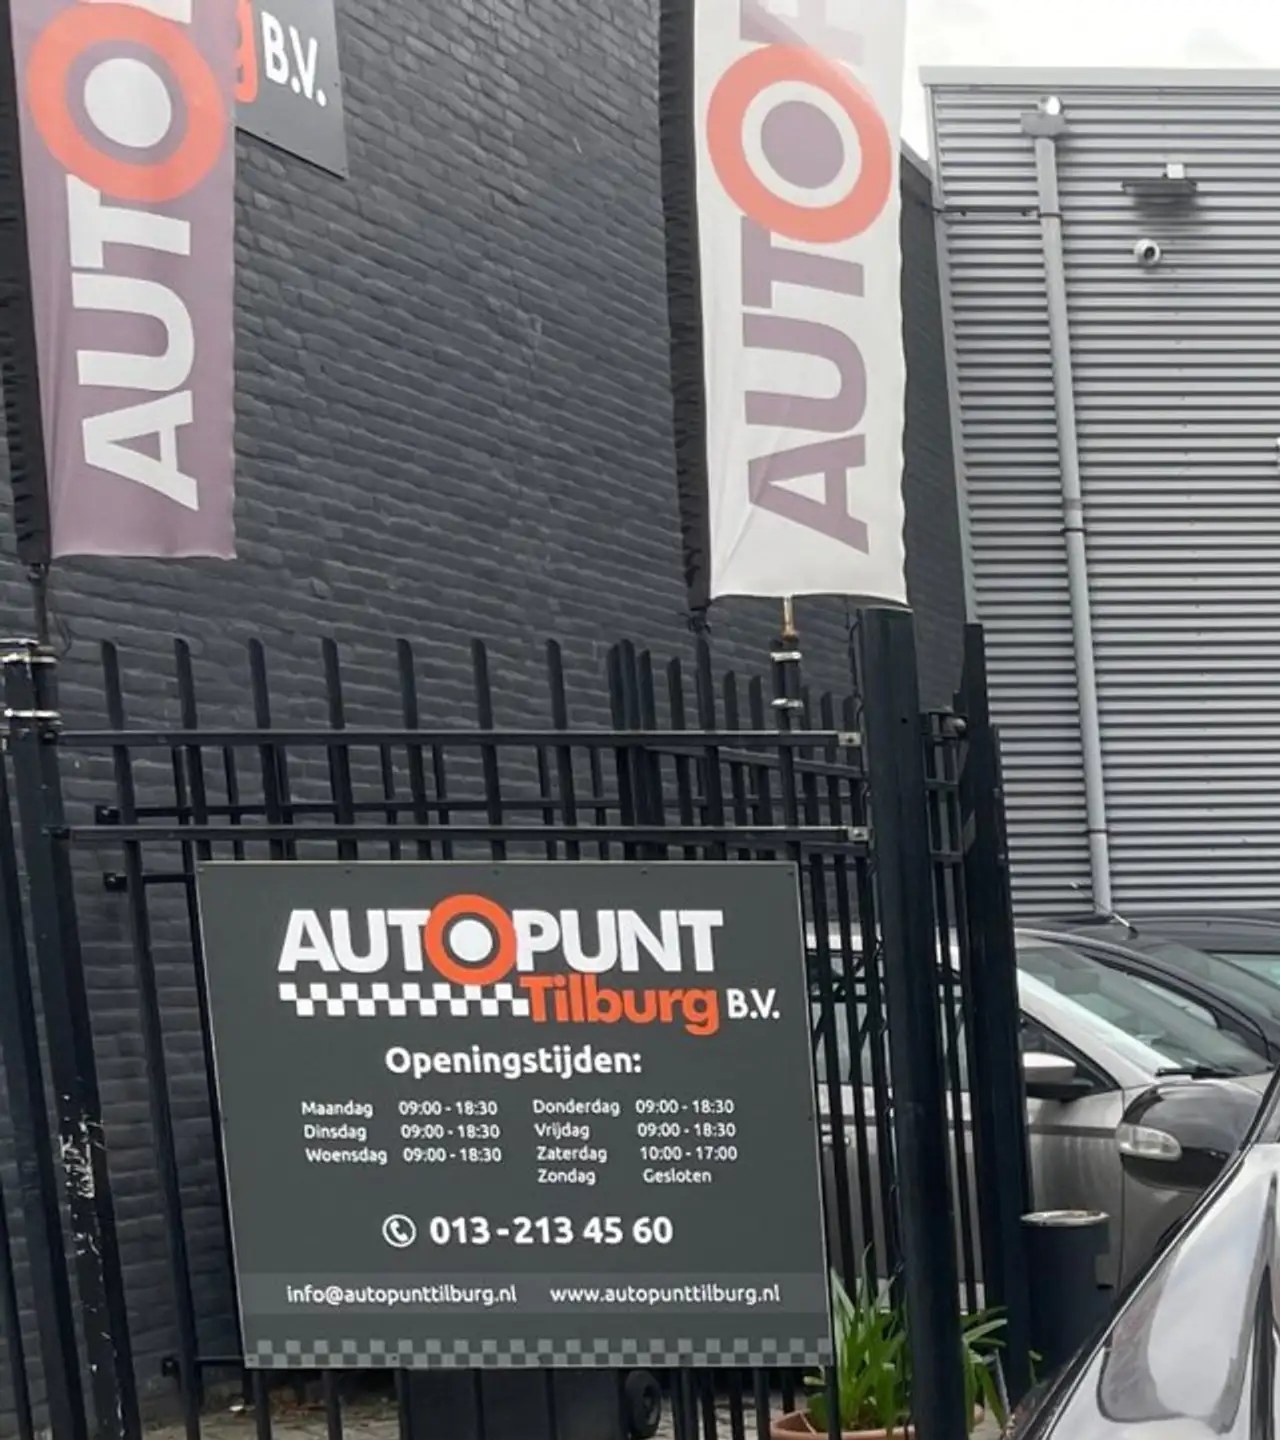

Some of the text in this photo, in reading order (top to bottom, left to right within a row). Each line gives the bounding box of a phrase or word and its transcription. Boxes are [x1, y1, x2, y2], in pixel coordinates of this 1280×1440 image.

[261, 11, 327, 107] B.V.
[26, 0, 226, 512] AUTO
[278, 894, 723, 986] AUTOPUNT
[520, 974, 780, 1036] Tilburg B.V.
[385, 1045, 642, 1080] Openingstijden:
[301, 1099, 374, 1119] Maandag
[398, 1101, 443, 1116] 09:00
[455, 1101, 498, 1116] 18:30
[532, 1099, 620, 1117] Donderdag
[635, 1099, 679, 1114] 09:00
[692, 1099, 735, 1114] 18:30
[303, 1123, 367, 1142] Dinsdag
[400, 1124, 445, 1139] 09:00
[457, 1124, 500, 1139] 18:30
[533, 1122, 590, 1140] Vrijdag
[637, 1123, 681, 1137] 09:00
[693, 1123, 736, 1137] 18:30
[305, 1147, 388, 1165] Woensdag
[402, 1148, 447, 1162] 09:00
[459, 1148, 502, 1162] 18:30
[536, 1145, 608, 1163] Zaterdag
[640, 1146, 683, 1161] 10:00
[695, 1146, 738, 1161] 17:00
[537, 1167, 713, 1186] Zondag Gesloten
[582, 1216, 624, 1244] 45
[633, 1216, 674, 1244] 60
[287, 1284, 517, 1306] info@autopunttilburg.nl
[550, 1284, 781, 1306] www.autopunttilburg.nl
